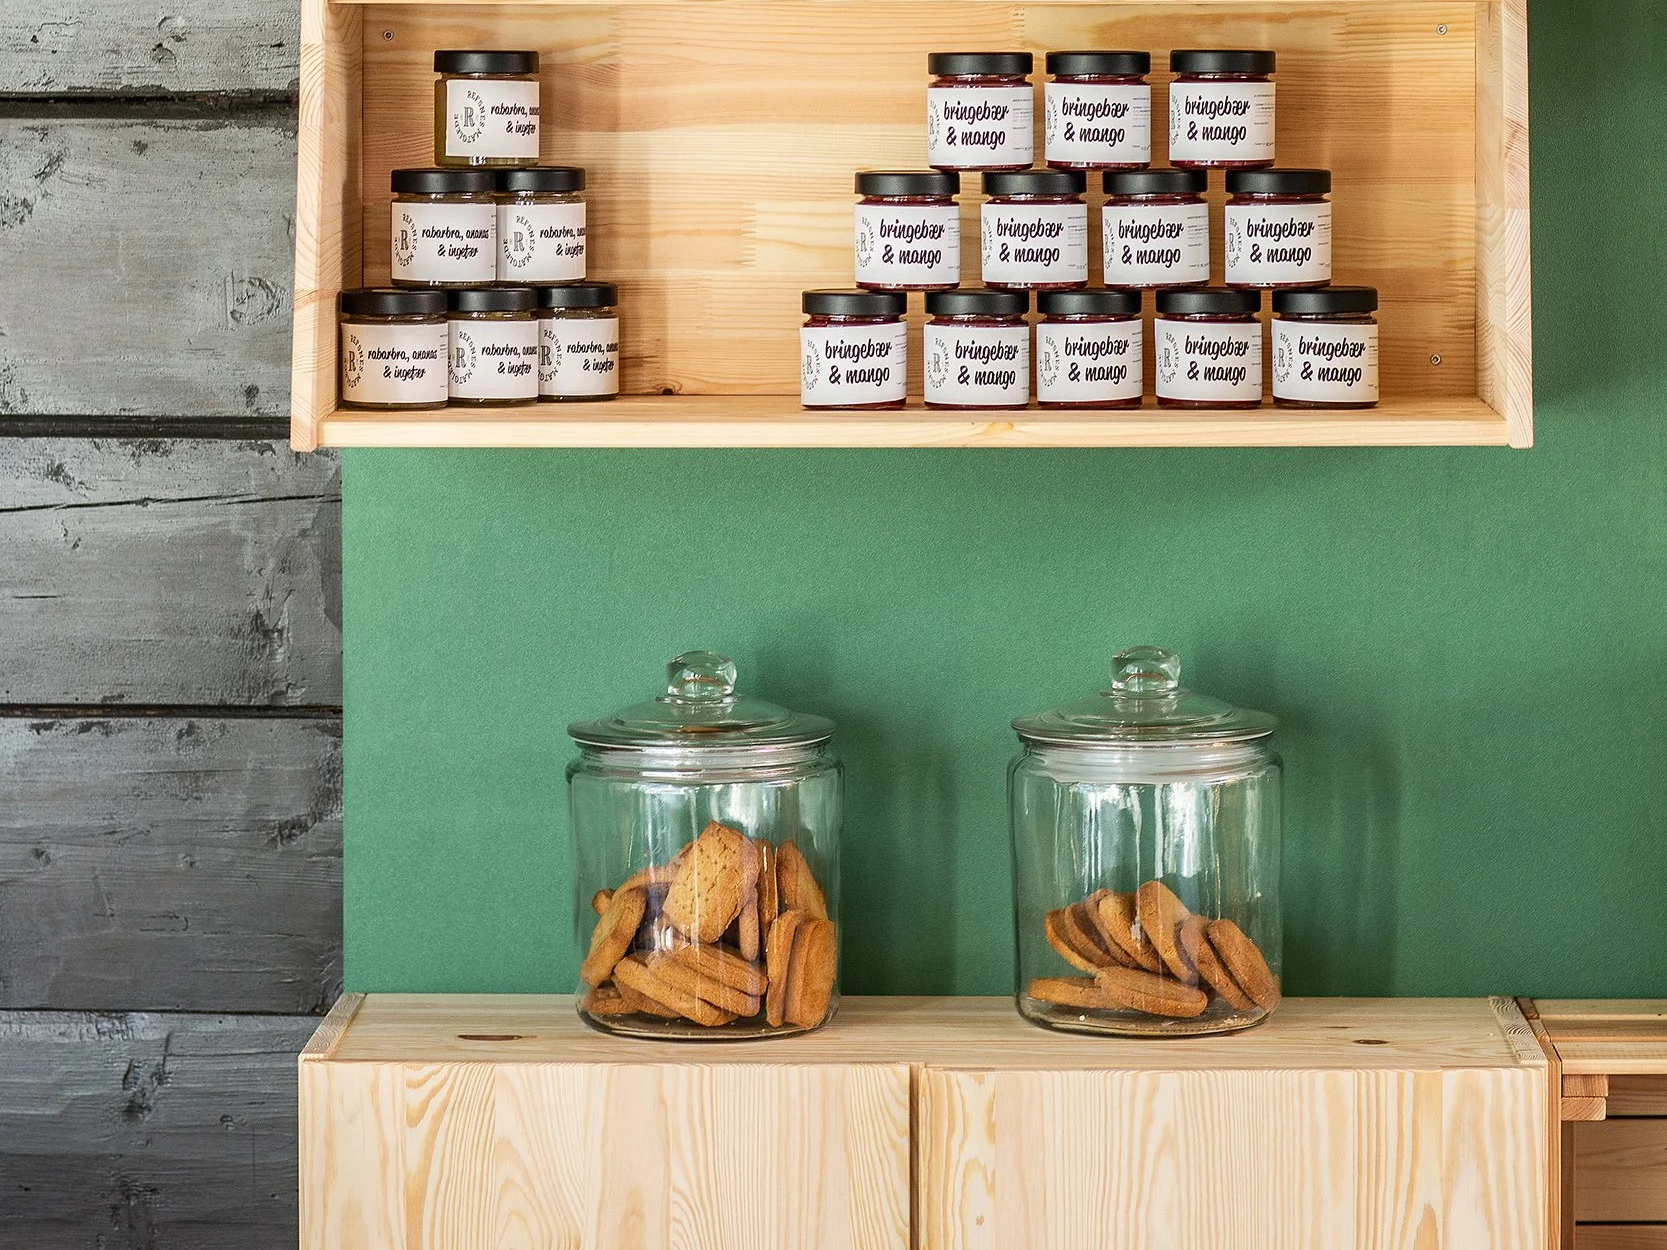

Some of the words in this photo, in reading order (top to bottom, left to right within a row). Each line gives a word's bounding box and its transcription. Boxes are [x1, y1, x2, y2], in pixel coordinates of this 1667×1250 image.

[490, 103, 527, 117] rabarbra,
[943, 100, 1009, 125] bringebær
[1062, 96, 1129, 122] bringebær
[1185, 95, 1250, 120] bringebær
[506, 120, 513, 133] &
[946, 126, 957, 146] &
[961, 131, 1006, 150] mango
[1064, 122, 1075, 142] &
[1079, 127, 1125, 147] mango
[1187, 121, 1198, 141] &
[1202, 126, 1246, 145] mango
[421, 225, 464, 241] rabarbra,
[539, 225, 576, 241] rabarbra,
[880, 218, 945, 243] bringebær
[997, 217, 1064, 242] bringebær
[1118, 218, 1184, 243] bringebær
[1246, 217, 1315, 242] bringebær
[437, 244, 446, 257] &
[556, 243, 563, 256] &
[882, 244, 894, 264] &
[899, 249, 942, 269] mango
[999, 243, 1010, 262] &
[1014, 248, 1060, 267] mango
[1121, 245, 1132, 265] &
[1136, 248, 1181, 268] mango
[1250, 243, 1262, 263] &
[1266, 247, 1312, 267] mango
[368, 347, 410, 362] rabarbra,
[481, 343, 521, 358] rabarbra,
[567, 341, 604, 357] rabarbra,
[825, 338, 892, 363] bringebær
[955, 339, 1019, 364] bringebær
[1064, 335, 1129, 360] bringebær
[1185, 335, 1249, 360] bringebær
[1298, 335, 1366, 361] bringebær
[383, 366, 391, 378] &
[497, 361, 506, 374] &
[582, 358, 591, 371] &
[829, 365, 841, 385] &
[846, 367, 890, 387] mango
[1068, 362, 1081, 382] &
[1085, 365, 1127, 385] mango
[1187, 361, 1200, 381] &
[1204, 366, 1246, 386] mango
[1300, 361, 1313, 381] &
[1318, 367, 1362, 387] mango
[957, 365, 970, 385] &
[974, 370, 1016, 390] mango
